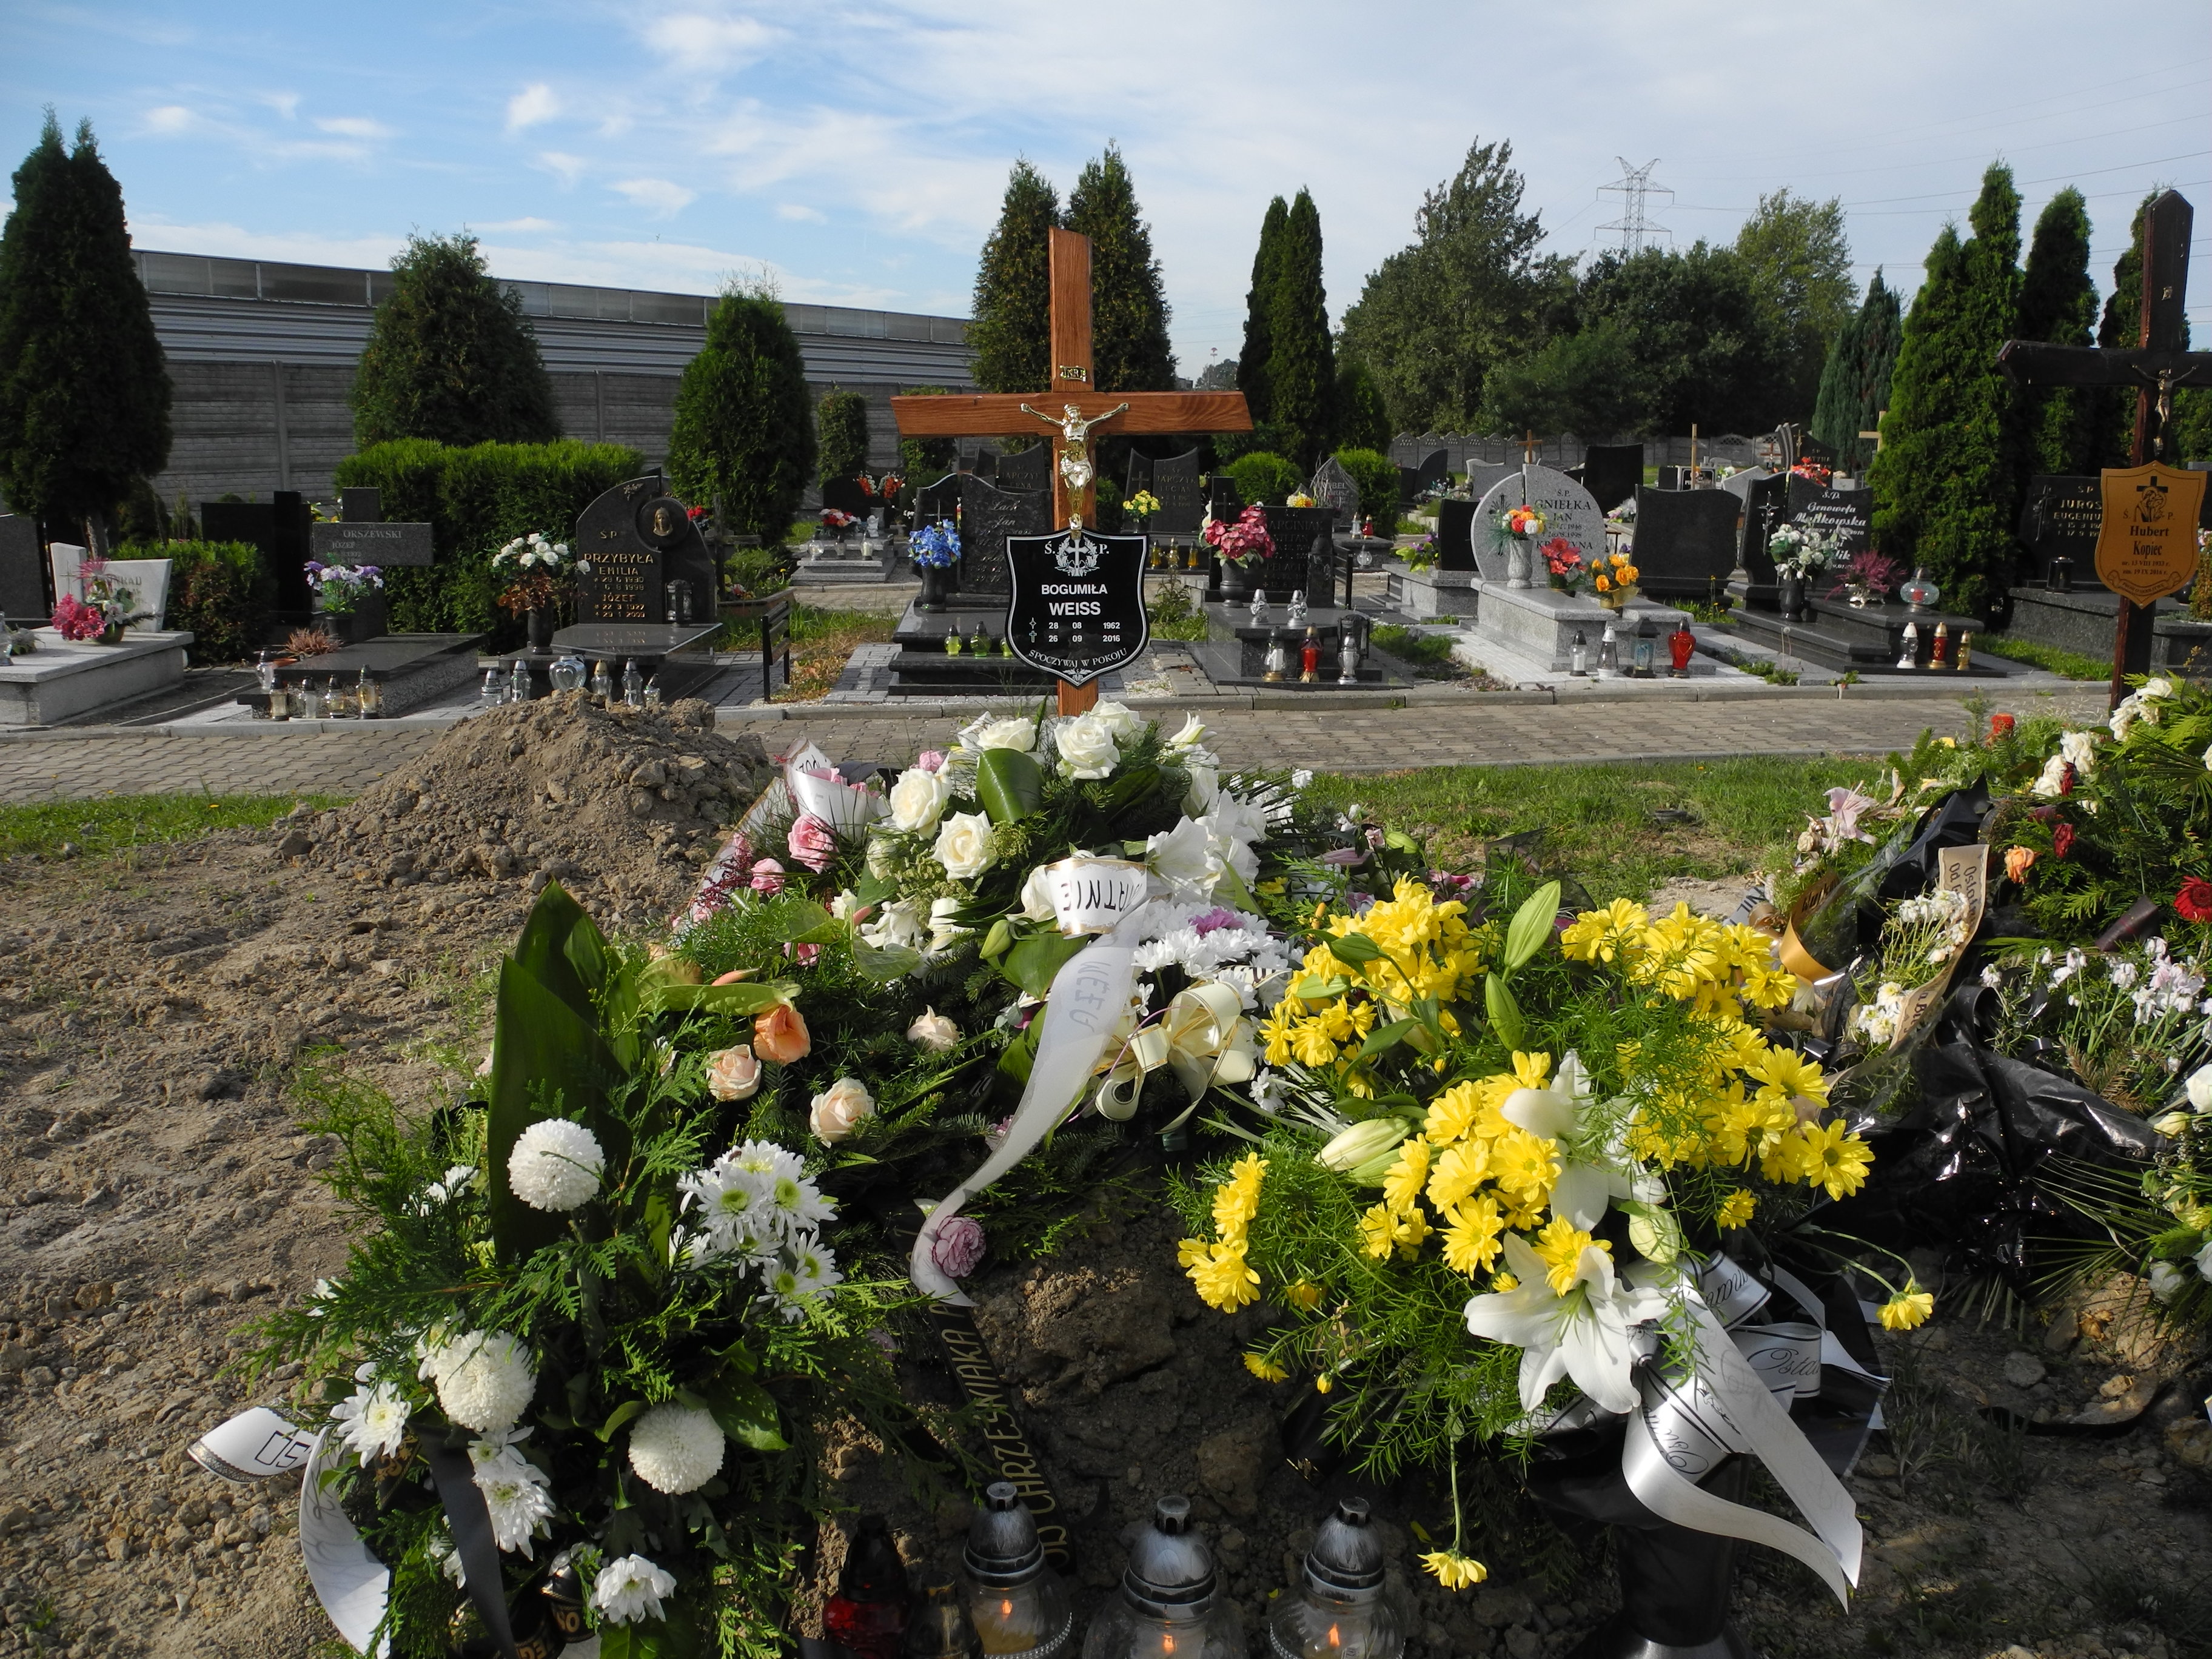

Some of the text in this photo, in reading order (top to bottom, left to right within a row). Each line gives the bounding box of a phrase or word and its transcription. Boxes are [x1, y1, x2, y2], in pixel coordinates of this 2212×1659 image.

[1535, 499, 1592, 510] GNIEŁKA
[2060, 500, 2103, 509] JUROS
[2054, 512, 2102, 520] EUGENIU
[343, 529, 402, 538] ORSZEWSKI
[2130, 525, 2170, 537] Hubert
[1044, 541, 1110, 554] Ś. P.
[2133, 540, 2163, 560] Kopiec
[584, 553, 654, 563] PRZYBYŁA
[599, 566, 639, 575] EMILIA
[1041, 583, 1108, 595] BOGUMIŁA
[602, 592, 636, 602] JÓZEF
[1049, 602, 1101, 615] WEISS
[1028, 648, 1127, 669] SPOCZYWAJ W POKOJU
